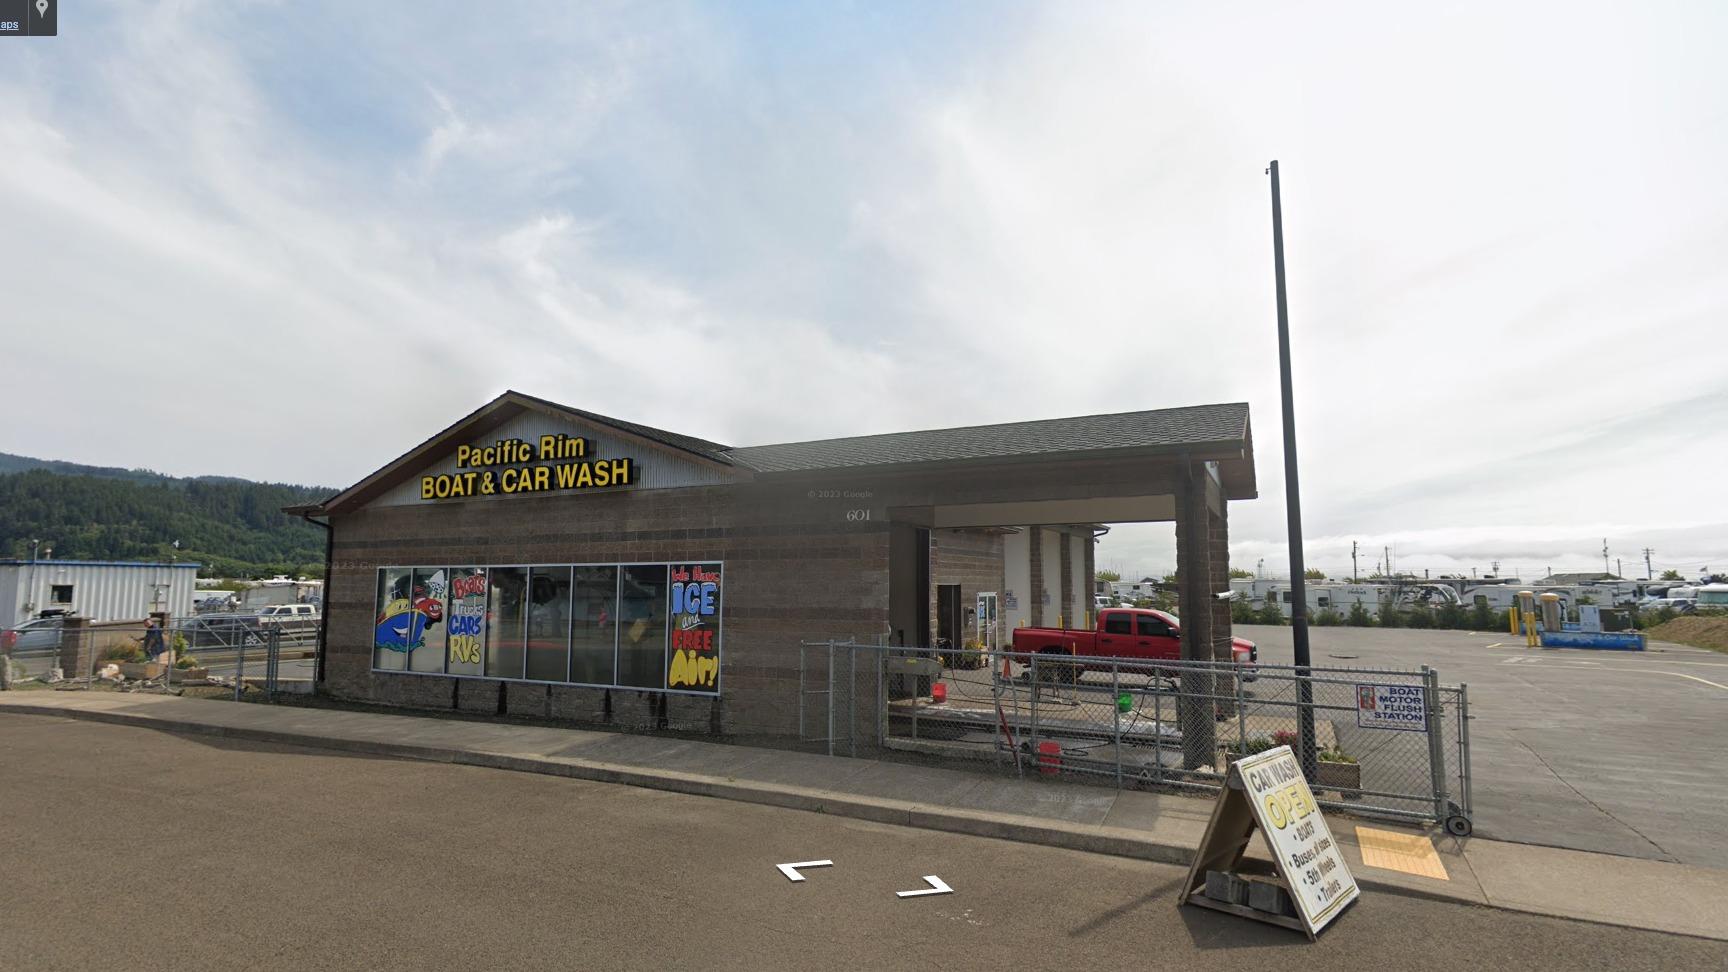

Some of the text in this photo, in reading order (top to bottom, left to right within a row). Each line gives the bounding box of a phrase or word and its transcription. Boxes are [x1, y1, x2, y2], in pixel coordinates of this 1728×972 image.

[457, 433, 586, 468] Pacific Rim
[421, 458, 630, 499] BOAT & CAR WASH
[846, 509, 870, 521] 601
[672, 582, 717, 615] ICE
[449, 614, 482, 636] CARS
[682, 614, 700, 629] and
[449, 634, 481, 664] RVs
[672, 629, 713, 651] FREE
[669, 648, 719, 687] Air!
[1379, 696, 1421, 705] MOTOR
[1384, 704, 1422, 713] FLUSH
[1375, 711, 1423, 721] STATION
[1250, 758, 1300, 793] CAR WASH
[1264, 781, 1316, 830] OPEN
[1306, 866, 1322, 886] 5th
